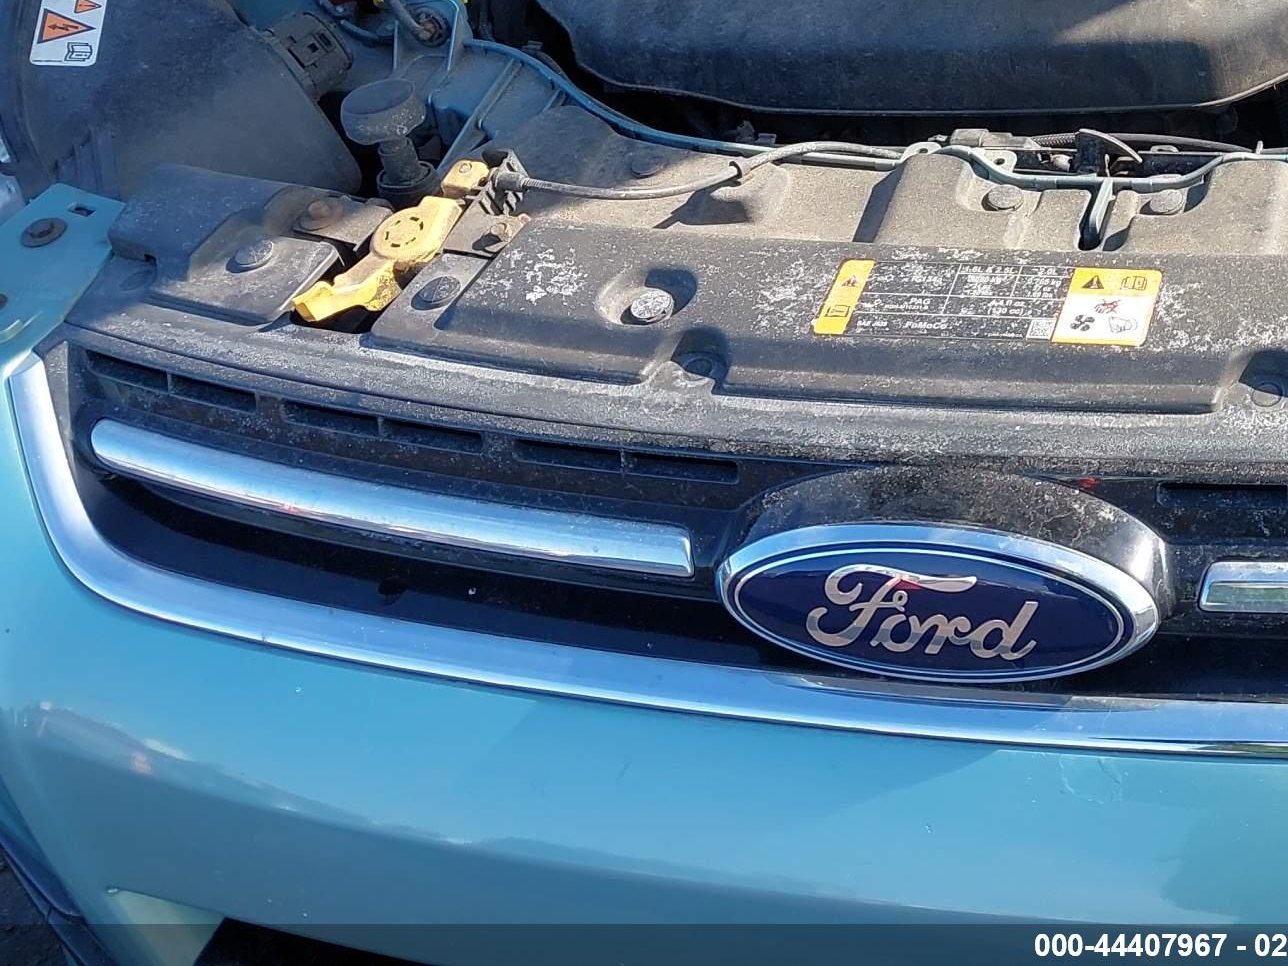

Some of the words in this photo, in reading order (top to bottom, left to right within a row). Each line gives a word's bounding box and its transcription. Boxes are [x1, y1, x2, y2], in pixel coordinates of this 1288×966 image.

[909, 297, 931, 305] PAG
[903, 321, 948, 330] FoMoCo
[805, 562, 1040, 662] Ford
